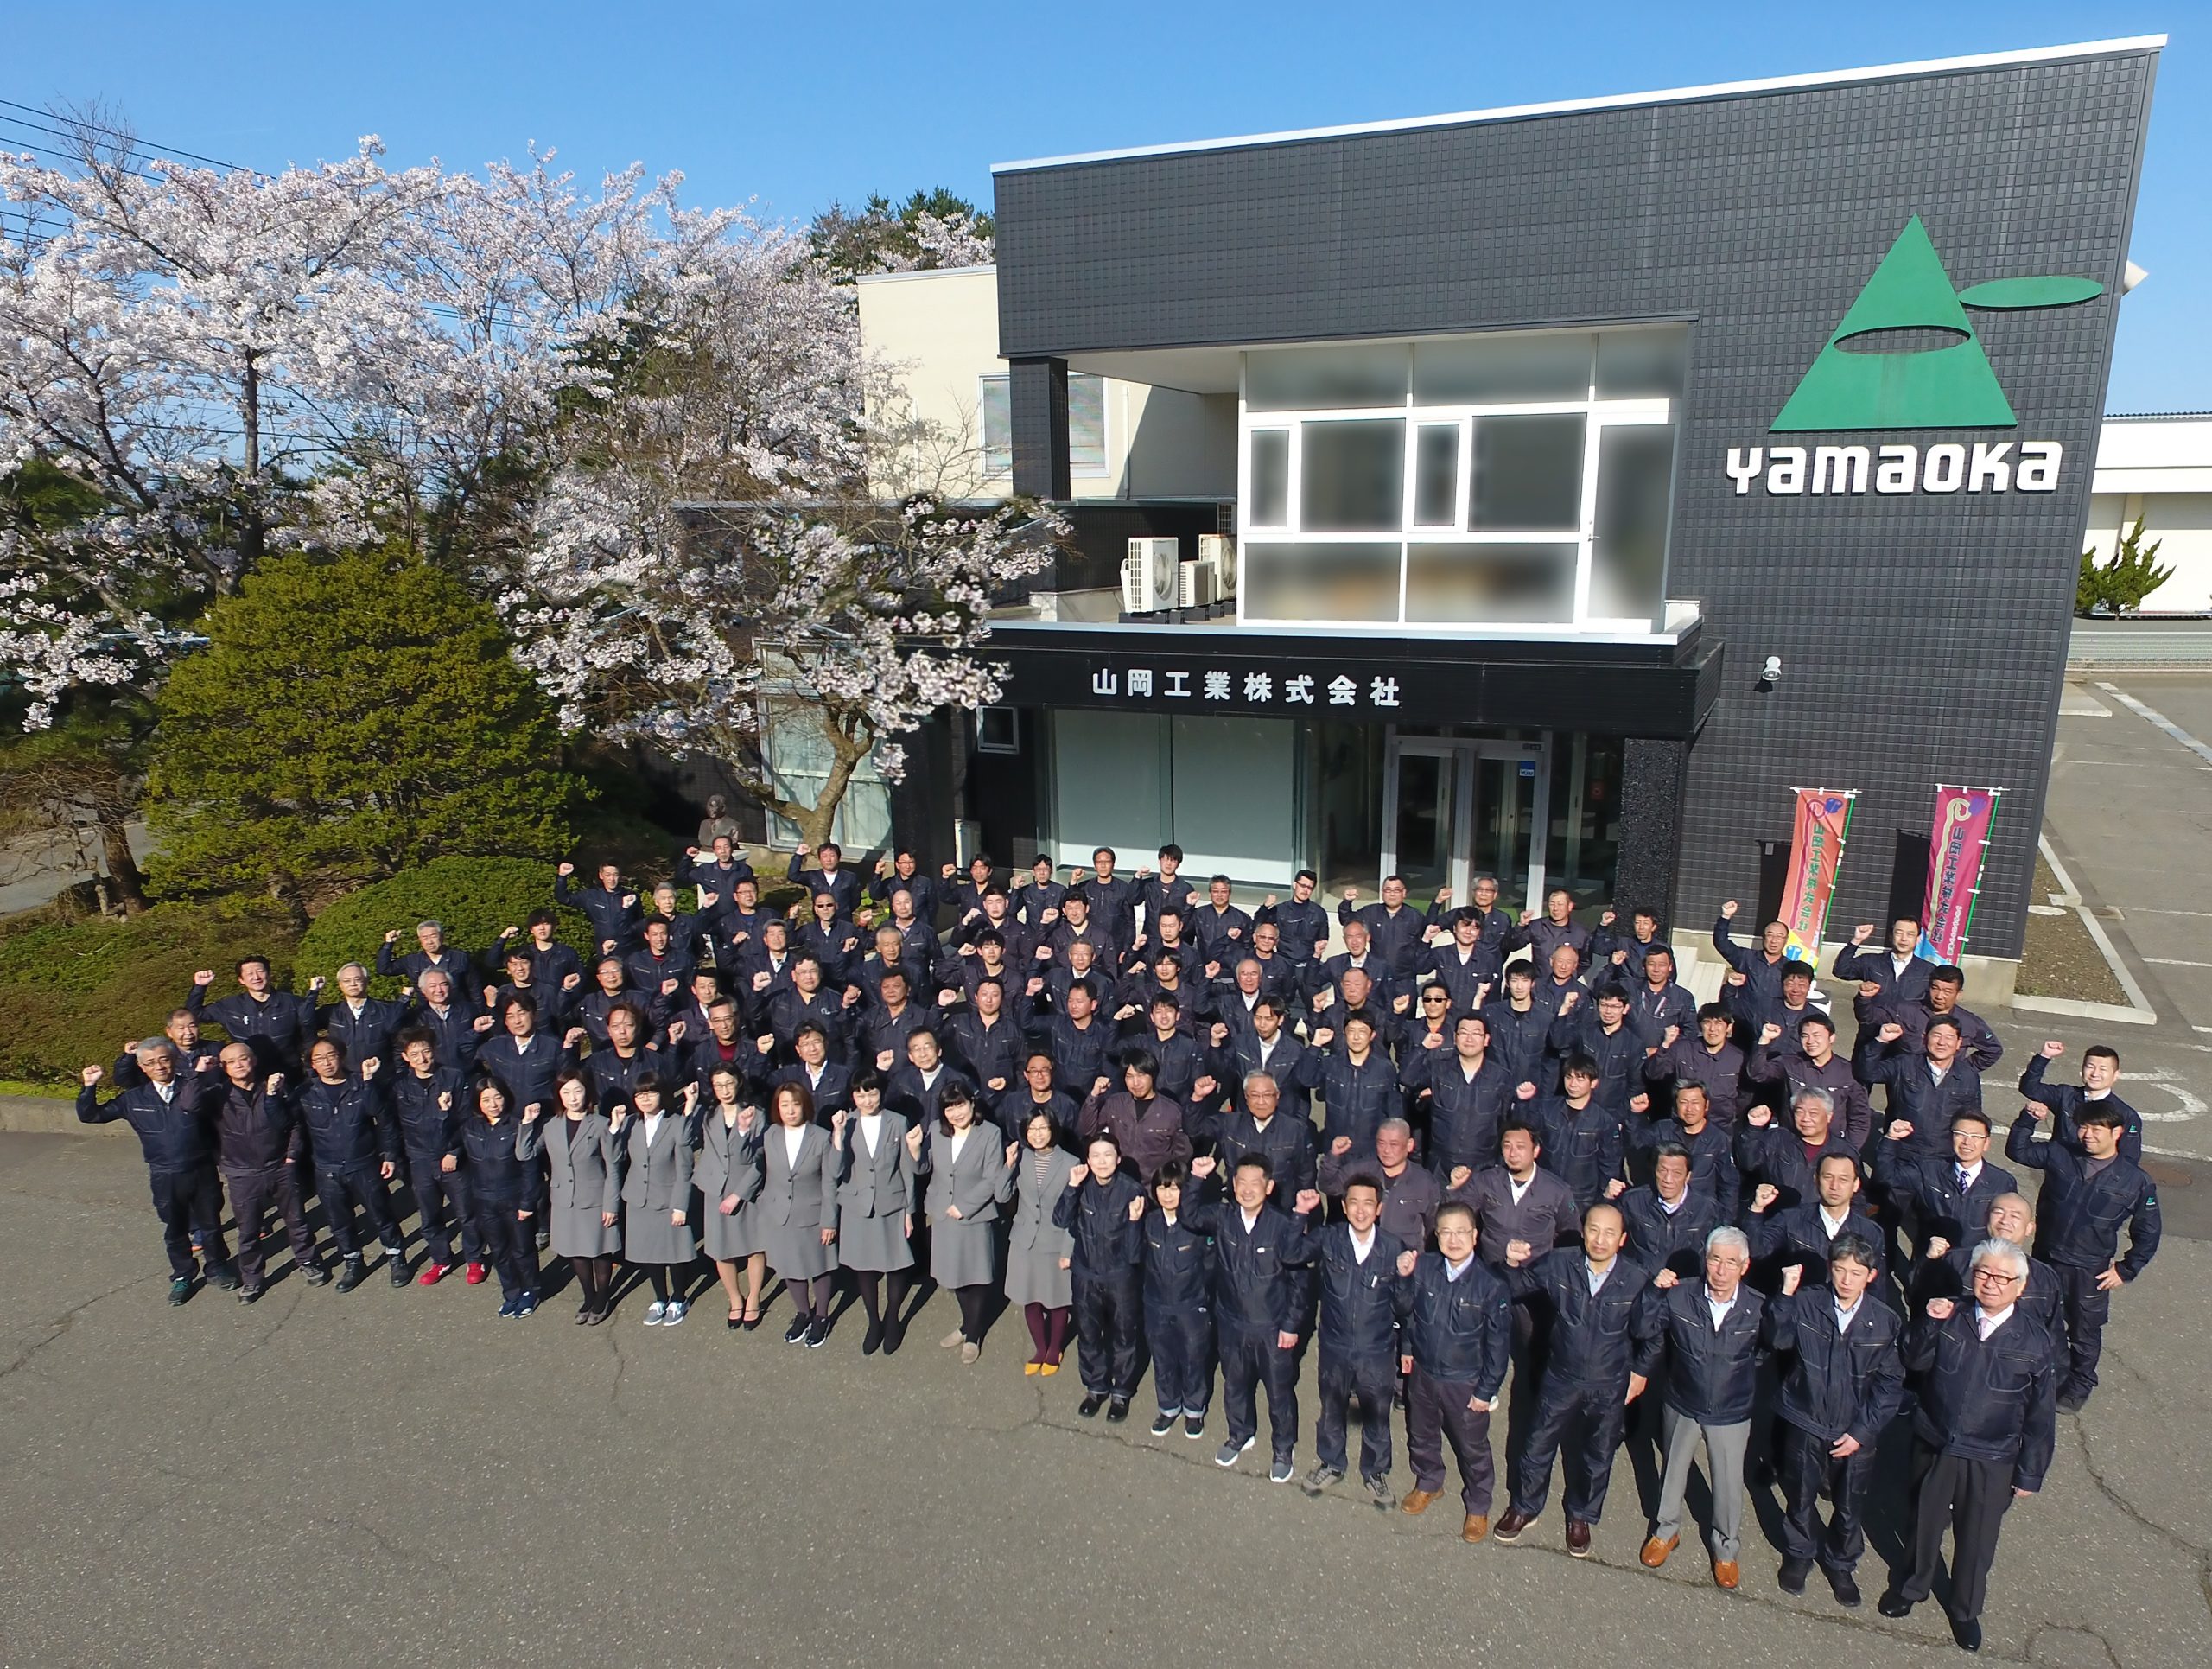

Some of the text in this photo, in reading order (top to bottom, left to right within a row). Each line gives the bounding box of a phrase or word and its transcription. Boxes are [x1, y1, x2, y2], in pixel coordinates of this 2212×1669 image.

[1092, 668, 1401, 707] 山岡工業株式会社
